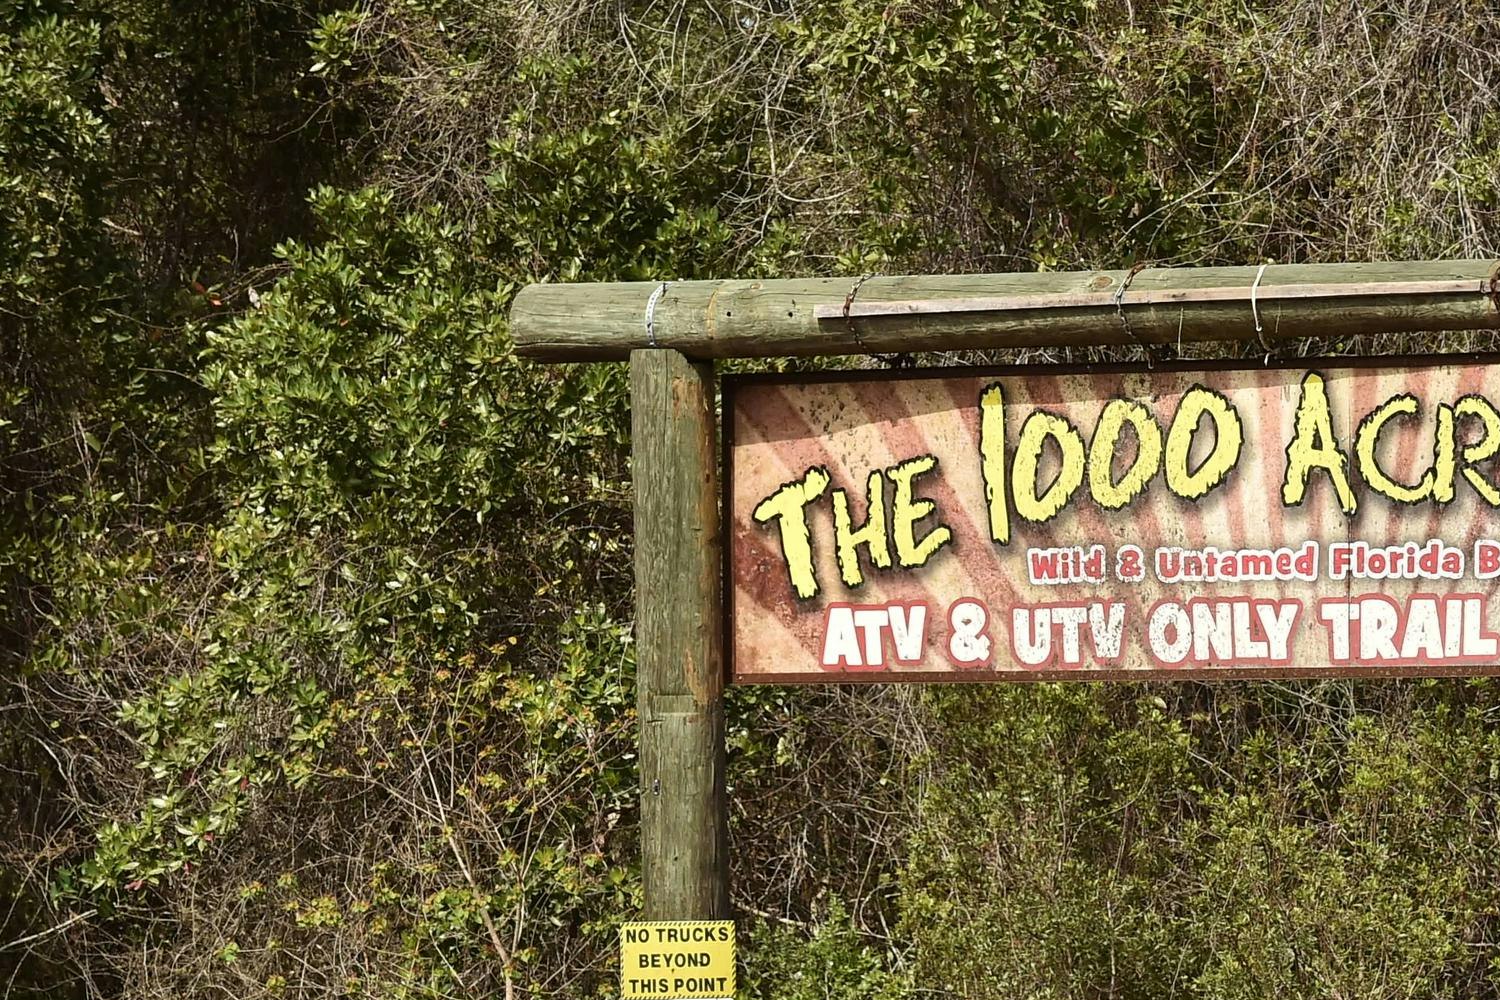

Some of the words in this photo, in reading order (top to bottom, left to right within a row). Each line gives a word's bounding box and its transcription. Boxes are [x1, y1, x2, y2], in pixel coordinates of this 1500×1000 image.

[753, 456, 952, 600] THE
[979, 382, 1244, 545] 1000
[1029, 548, 1103, 583] Wild
[1117, 547, 1143, 580] &
[1157, 545, 1317, 582] Untamed
[1331, 543, 1463, 580] Florida
[822, 605, 926, 666] ATV
[950, 602, 991, 663] &
[1012, 602, 1126, 664] UTV
[1148, 601, 1298, 662] ONLY
[1321, 594, 1499, 661] TRAIL
[625, 928, 650, 944] NO
[655, 926, 729, 943] TRUCKS
[638, 952, 711, 969] BEYOND
[628, 978, 669, 993] THIS
[674, 977, 728, 993] POINT
